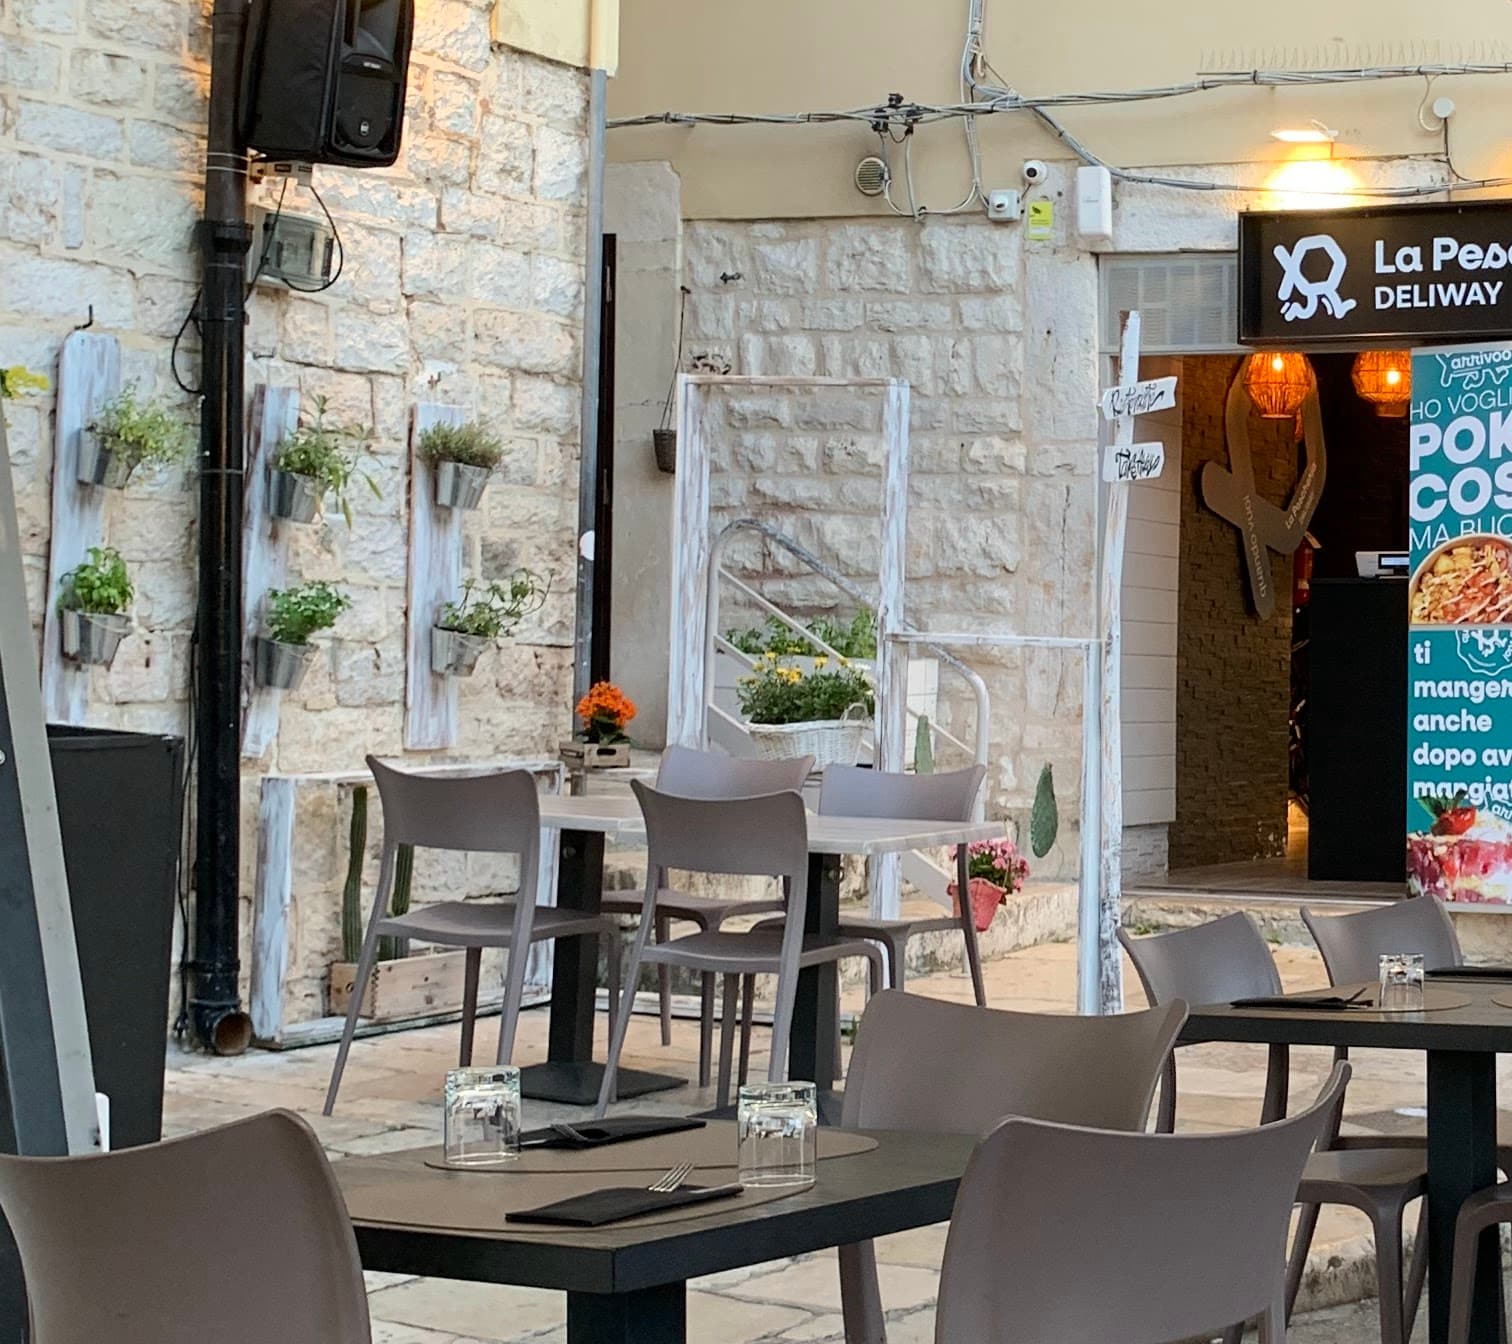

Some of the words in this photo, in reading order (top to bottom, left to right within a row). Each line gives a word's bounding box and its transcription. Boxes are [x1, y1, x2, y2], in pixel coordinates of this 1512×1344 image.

[1375, 239, 1422, 274] La
[1374, 281, 1504, 309] DELIWAY
[1411, 398, 1441, 420] HO
[1410, 524, 1449, 551] MA
[1413, 640, 1431, 665] ti
[1412, 709, 1492, 732] anche
[1412, 742, 1477, 771] dopo
